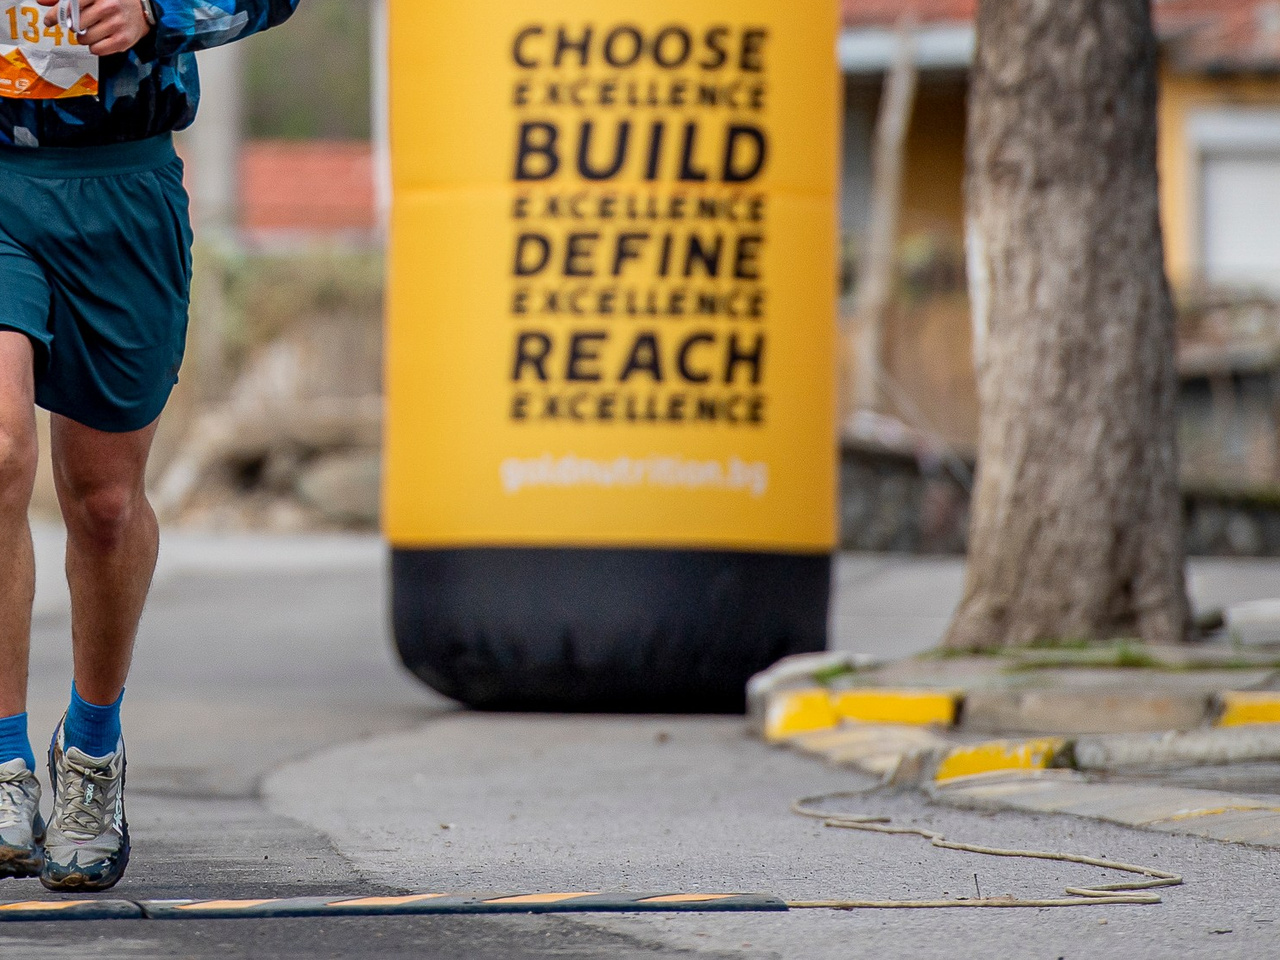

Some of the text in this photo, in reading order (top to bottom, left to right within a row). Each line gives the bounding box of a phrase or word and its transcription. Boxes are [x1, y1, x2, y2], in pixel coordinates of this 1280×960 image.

[511, 24, 769, 72] CHOOSE
[511, 77, 769, 110] EXCELLENCE
[511, 119, 769, 183] BUILD
[511, 192, 769, 223] EXCELLENCE
[511, 230, 769, 281] DEFINE
[511, 286, 769, 318] EXCELLENCE
[511, 329, 769, 385] REACH
[511, 391, 769, 425] EXCELLENCE
